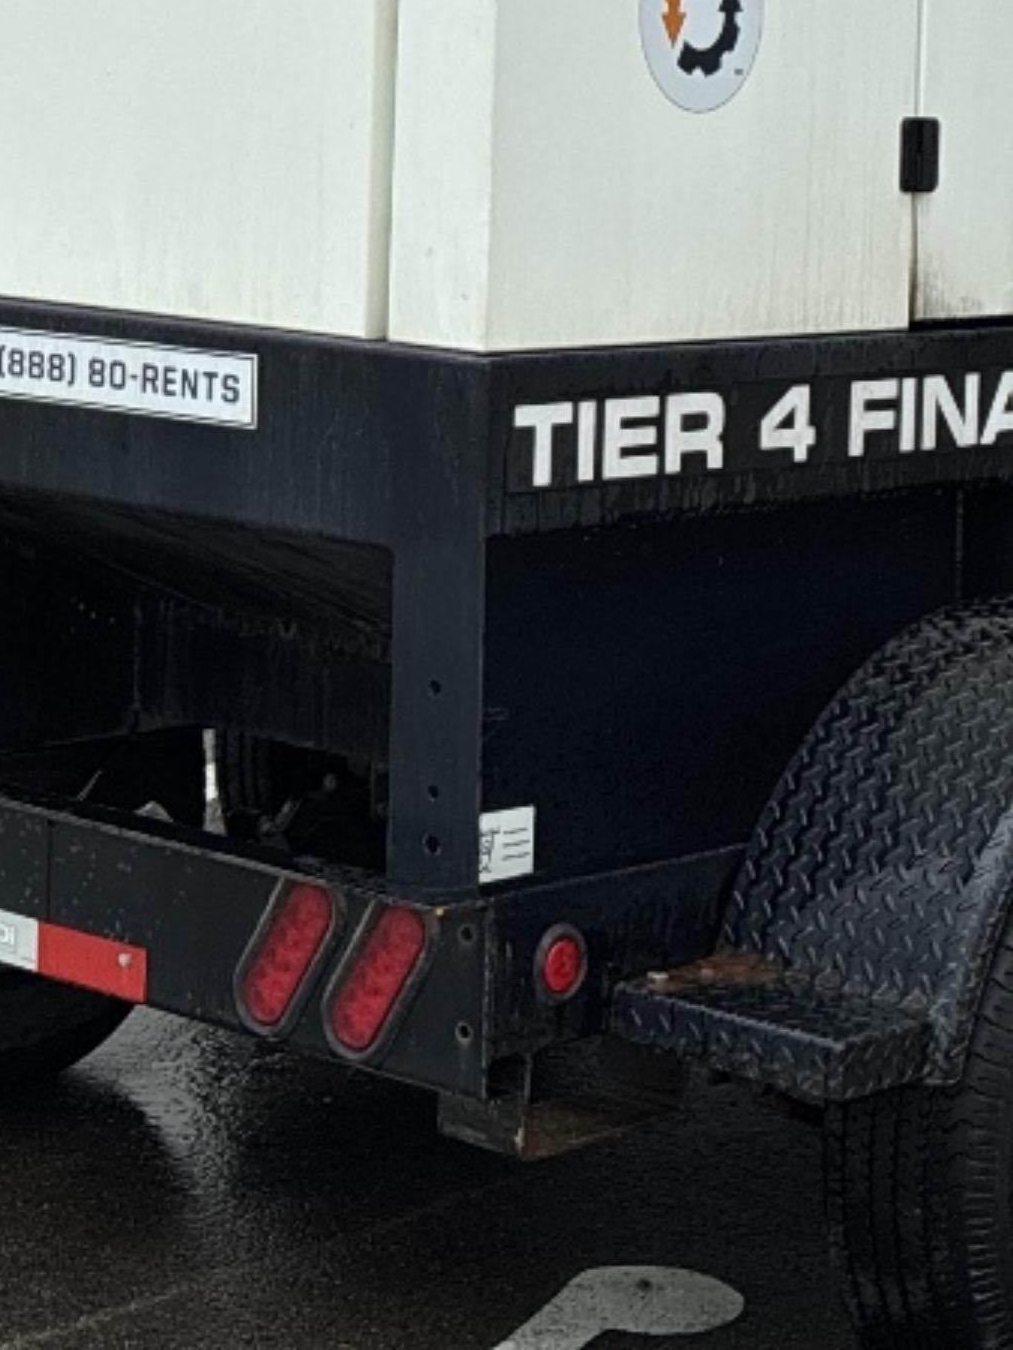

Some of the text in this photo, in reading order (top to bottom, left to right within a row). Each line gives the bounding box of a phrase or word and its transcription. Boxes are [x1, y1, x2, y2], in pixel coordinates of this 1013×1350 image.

[88, 357, 240, 404] 80-RENTS
[512, 391, 726, 487] TIER
[758, 383, 816, 463] 4
